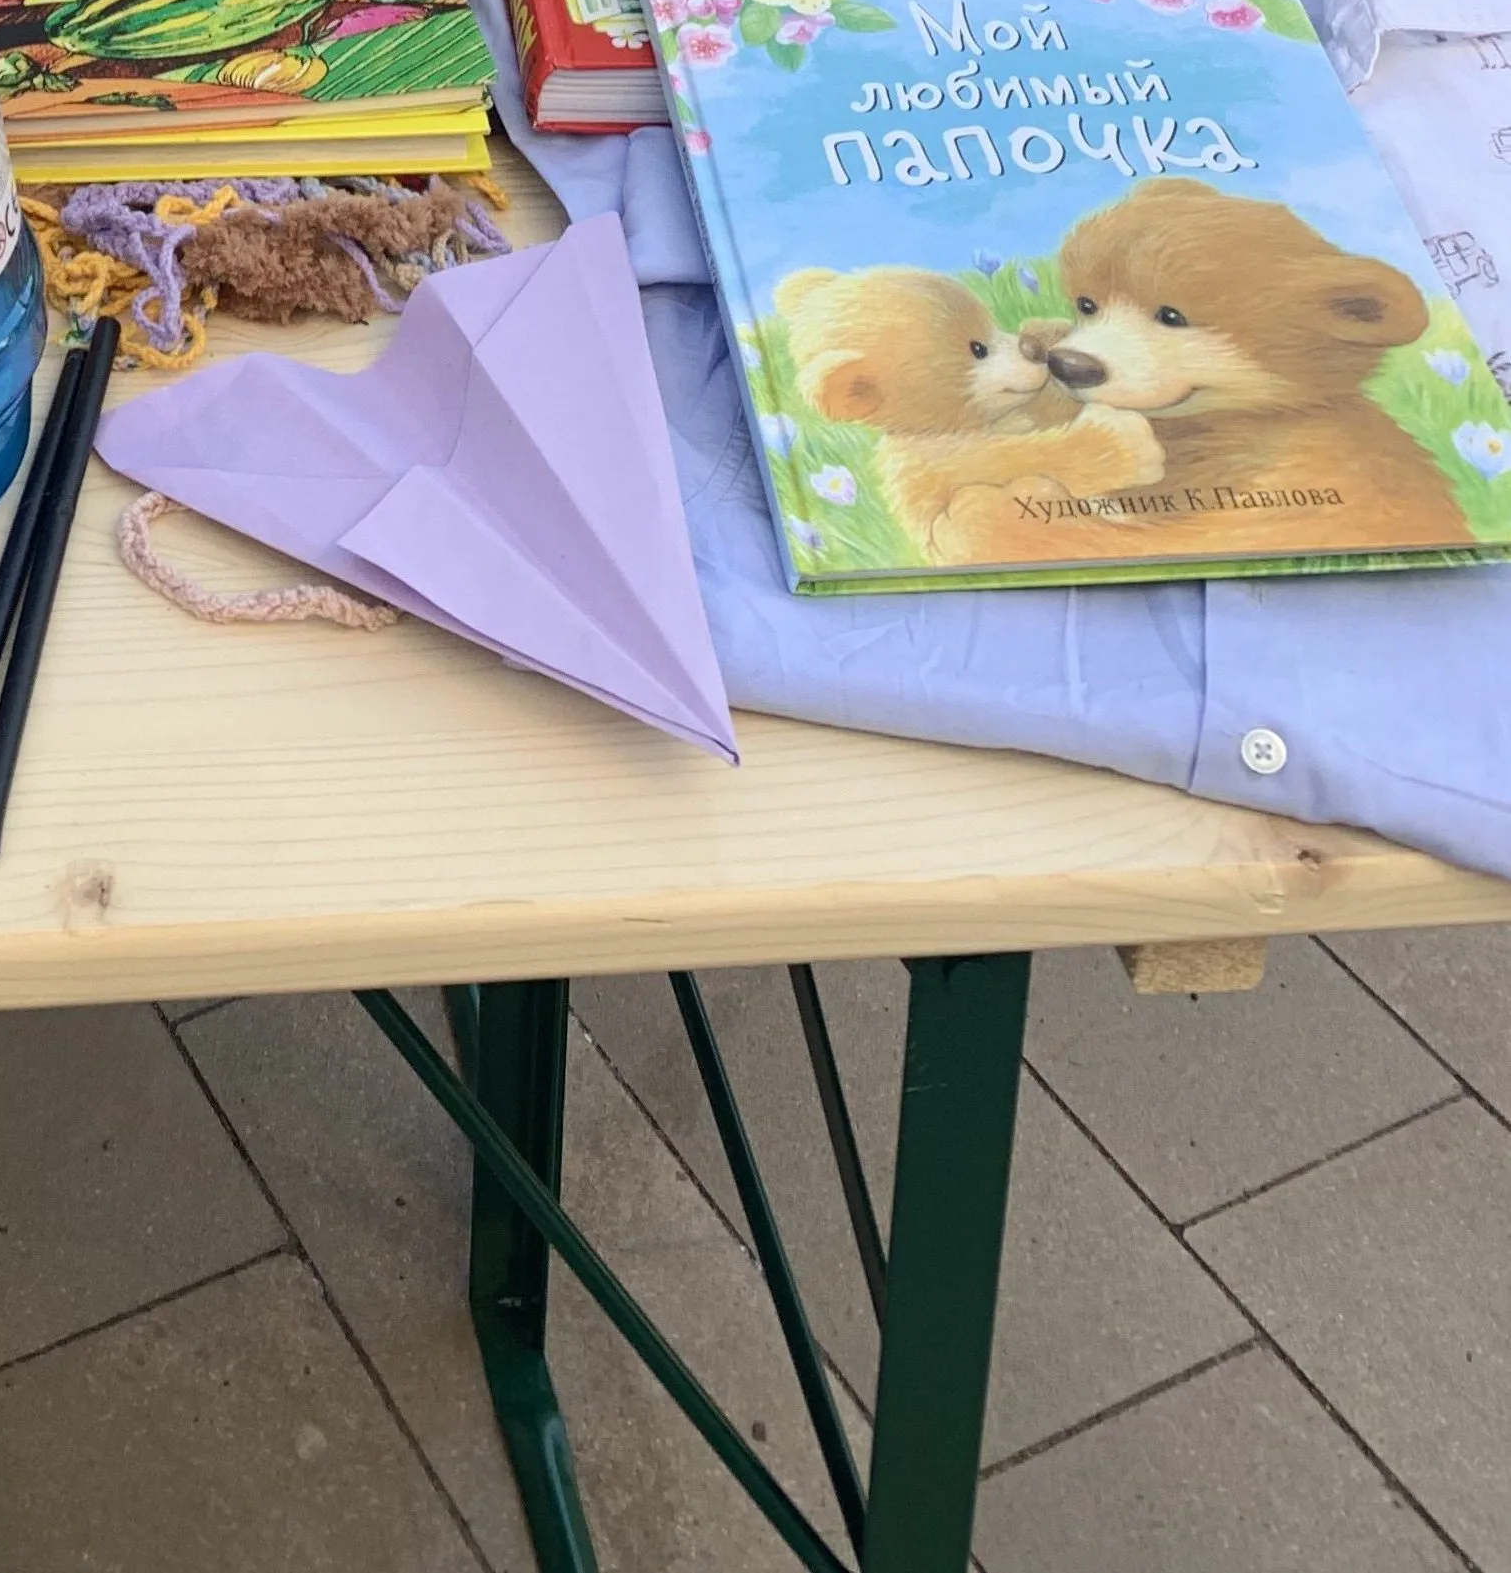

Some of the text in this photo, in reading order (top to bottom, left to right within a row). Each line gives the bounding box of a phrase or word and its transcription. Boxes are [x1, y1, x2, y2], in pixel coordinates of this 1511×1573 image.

[849, 58, 1172, 115] любимый
[822, 112, 1260, 188] папочка
[1012, 485, 1345, 525] Художник К.Павлова
